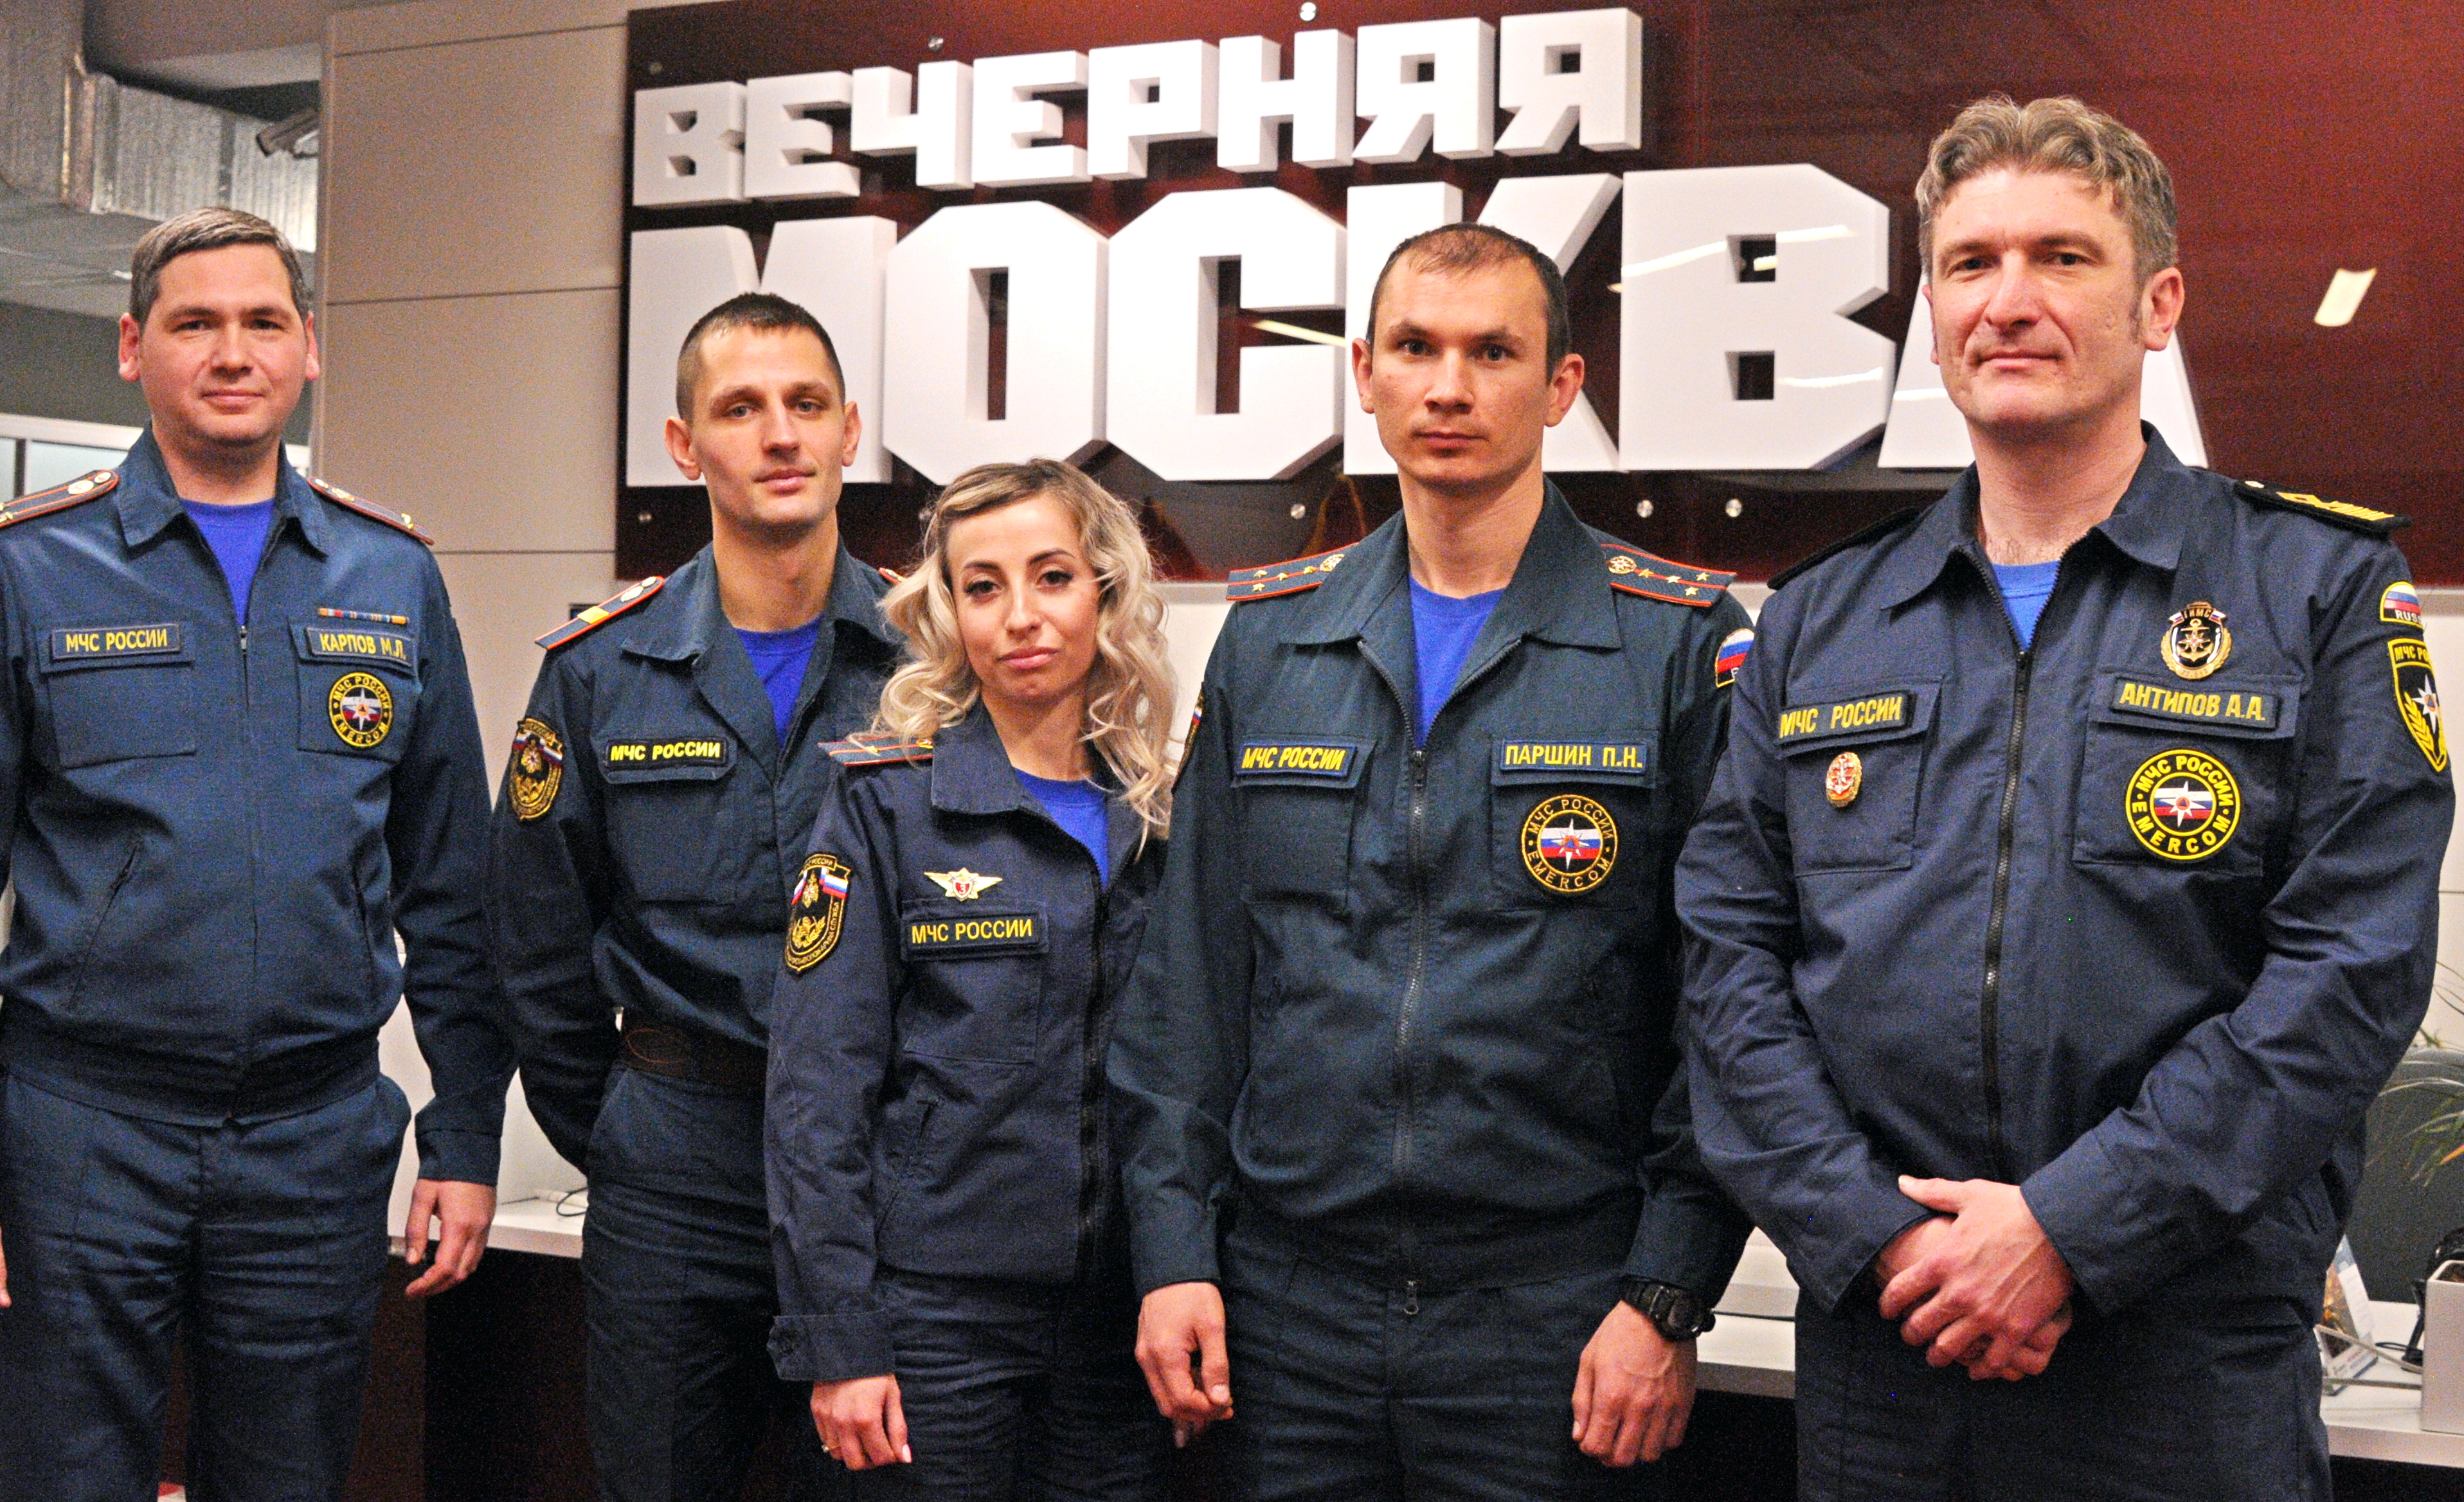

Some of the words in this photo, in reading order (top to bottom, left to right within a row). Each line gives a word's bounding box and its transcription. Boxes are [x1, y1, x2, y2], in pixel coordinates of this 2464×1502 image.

[633, 10, 1643, 208] ВЕЧЕРНЯЯ
[626, 163, 2209, 487] МОСКВ
[66, 633, 100, 652] МЧС
[105, 628, 168, 650] РОССИИ
[319, 633, 377, 654] КАРПОВ
[380, 637, 407, 660] М.Л.
[2394, 645, 2416, 661] МЧС
[333, 679, 352, 702] МЧС
[354, 676, 391, 710] РОССИИ
[2119, 683, 2222, 717] АНТИПОВ
[2225, 694, 2265, 721] А.А.
[333, 713, 388, 744] EMERCOM
[1779, 708, 1819, 739] МЧС
[1830, 696, 1903, 729] РОССИИ
[611, 744, 646, 762] МЧС
[652, 741, 721, 760] РОССИИ
[1241, 746, 1278, 769] МЧС
[1278, 746, 1345, 771] РОССИИ
[1505, 744, 1592, 766] ПАРШИН
[1603, 746, 1643, 768] П.Н.
[2135, 759, 2172, 793] МЧС
[2175, 755, 2235, 807] РОССИИ
[1527, 804, 1554, 834] МЧС
[1561, 798, 1614, 839] РОССИИ
[2132, 801, 2232, 854] EMERCOM
[1527, 850, 1610, 889] EMERCOM
[912, 924, 949, 943] МЧС
[955, 918, 1032, 941] РОССИИ
